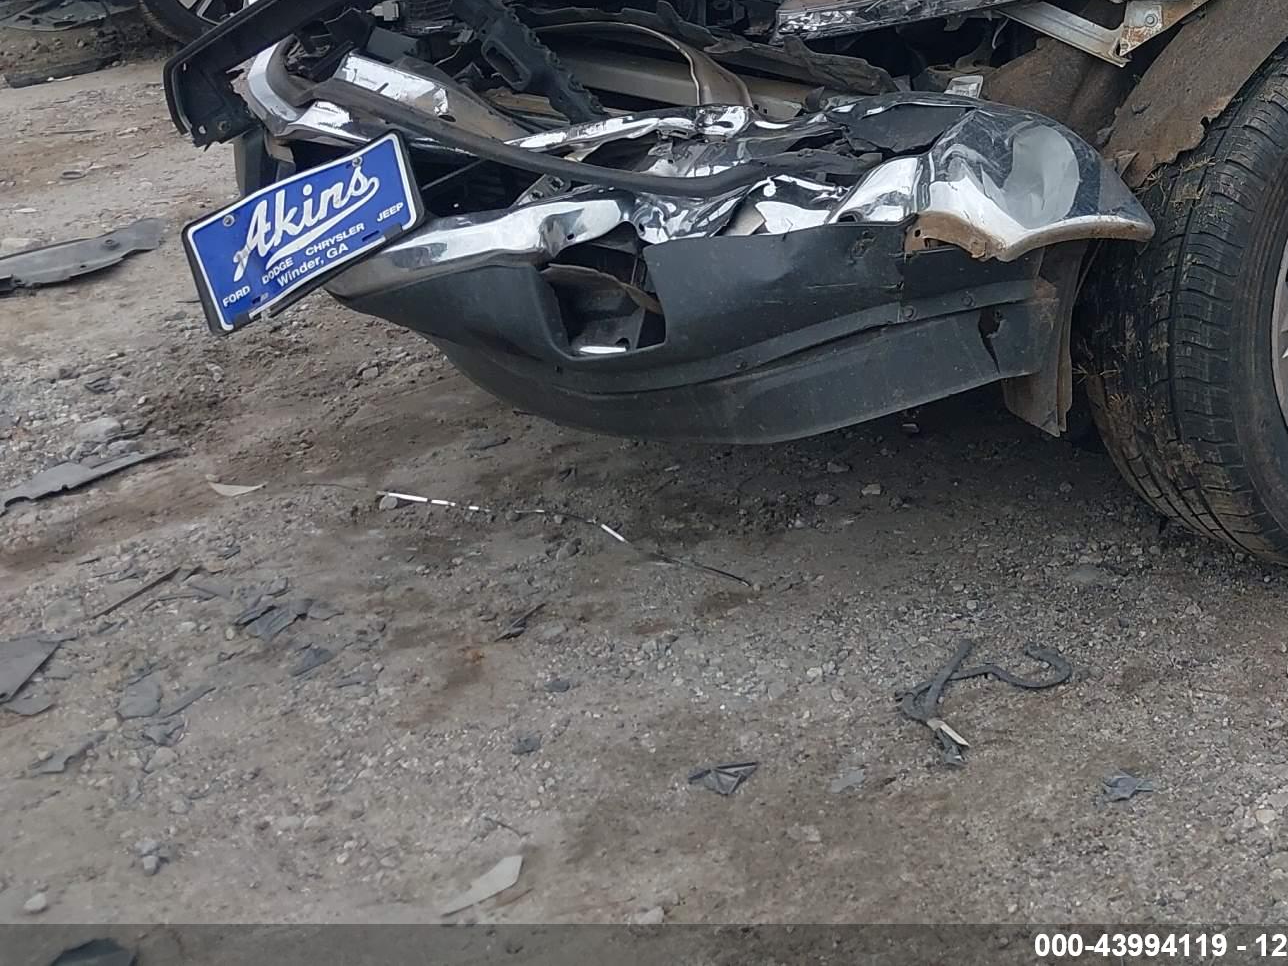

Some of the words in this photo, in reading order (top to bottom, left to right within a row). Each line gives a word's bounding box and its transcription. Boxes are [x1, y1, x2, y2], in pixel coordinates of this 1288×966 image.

[222, 285, 251, 308] FORD
[262, 256, 294, 284] DODGE
[305, 222, 365, 256] CHRYSLER
[376, 202, 404, 222] JEEP
[233, 166, 379, 282] Akins
[277, 256, 325, 288] Winder,
[326, 243, 349, 260] GA
